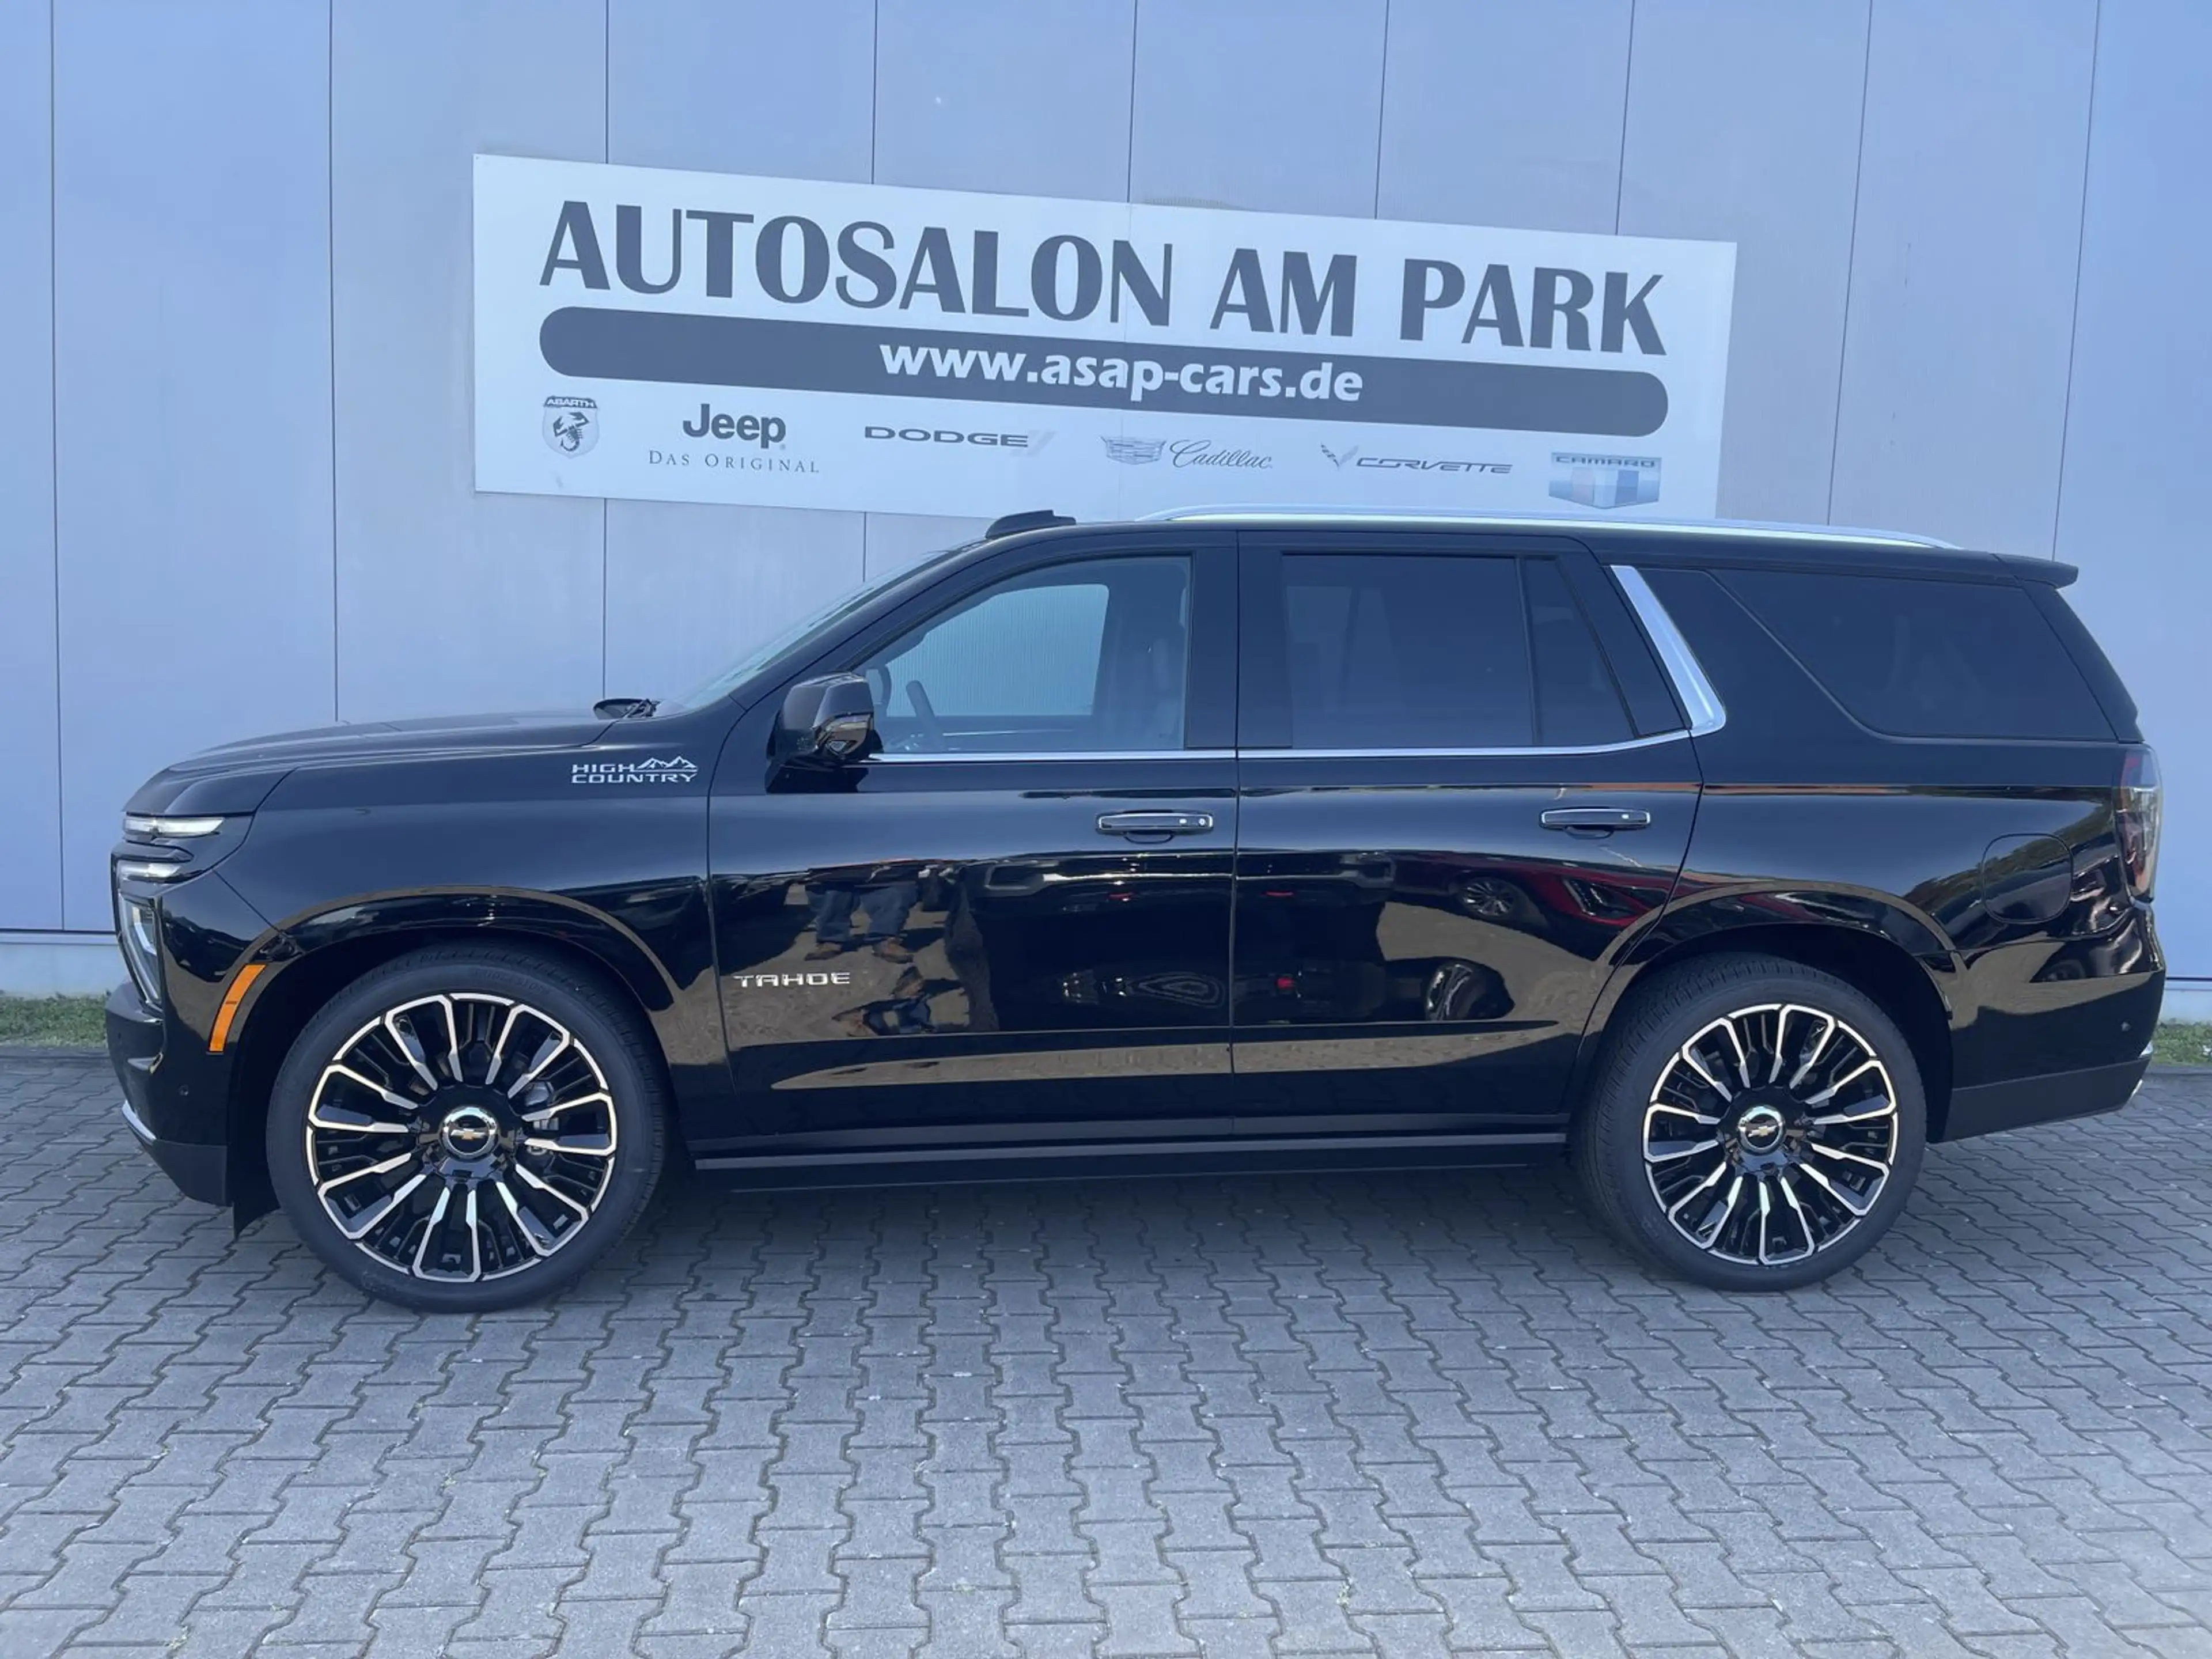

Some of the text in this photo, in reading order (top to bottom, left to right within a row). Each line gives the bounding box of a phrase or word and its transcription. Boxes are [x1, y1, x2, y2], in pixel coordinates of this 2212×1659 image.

[539, 200, 1668, 356] AUTOSALON AM PARK
[879, 344, 1363, 402] www.asap-cars.de
[547, 398, 594, 407] ABARTH
[682, 403, 786, 449] Jeep
[864, 426, 1029, 448] DODGE
[1169, 439, 1273, 469] Cadillac
[1555, 456, 1656, 468] CAMARO
[1356, 457, 1514, 474] CORVETTE
[571, 763, 635, 774] HIGH
[571, 772, 698, 784] COUNTRY
[732, 971, 851, 988] TAHOE
